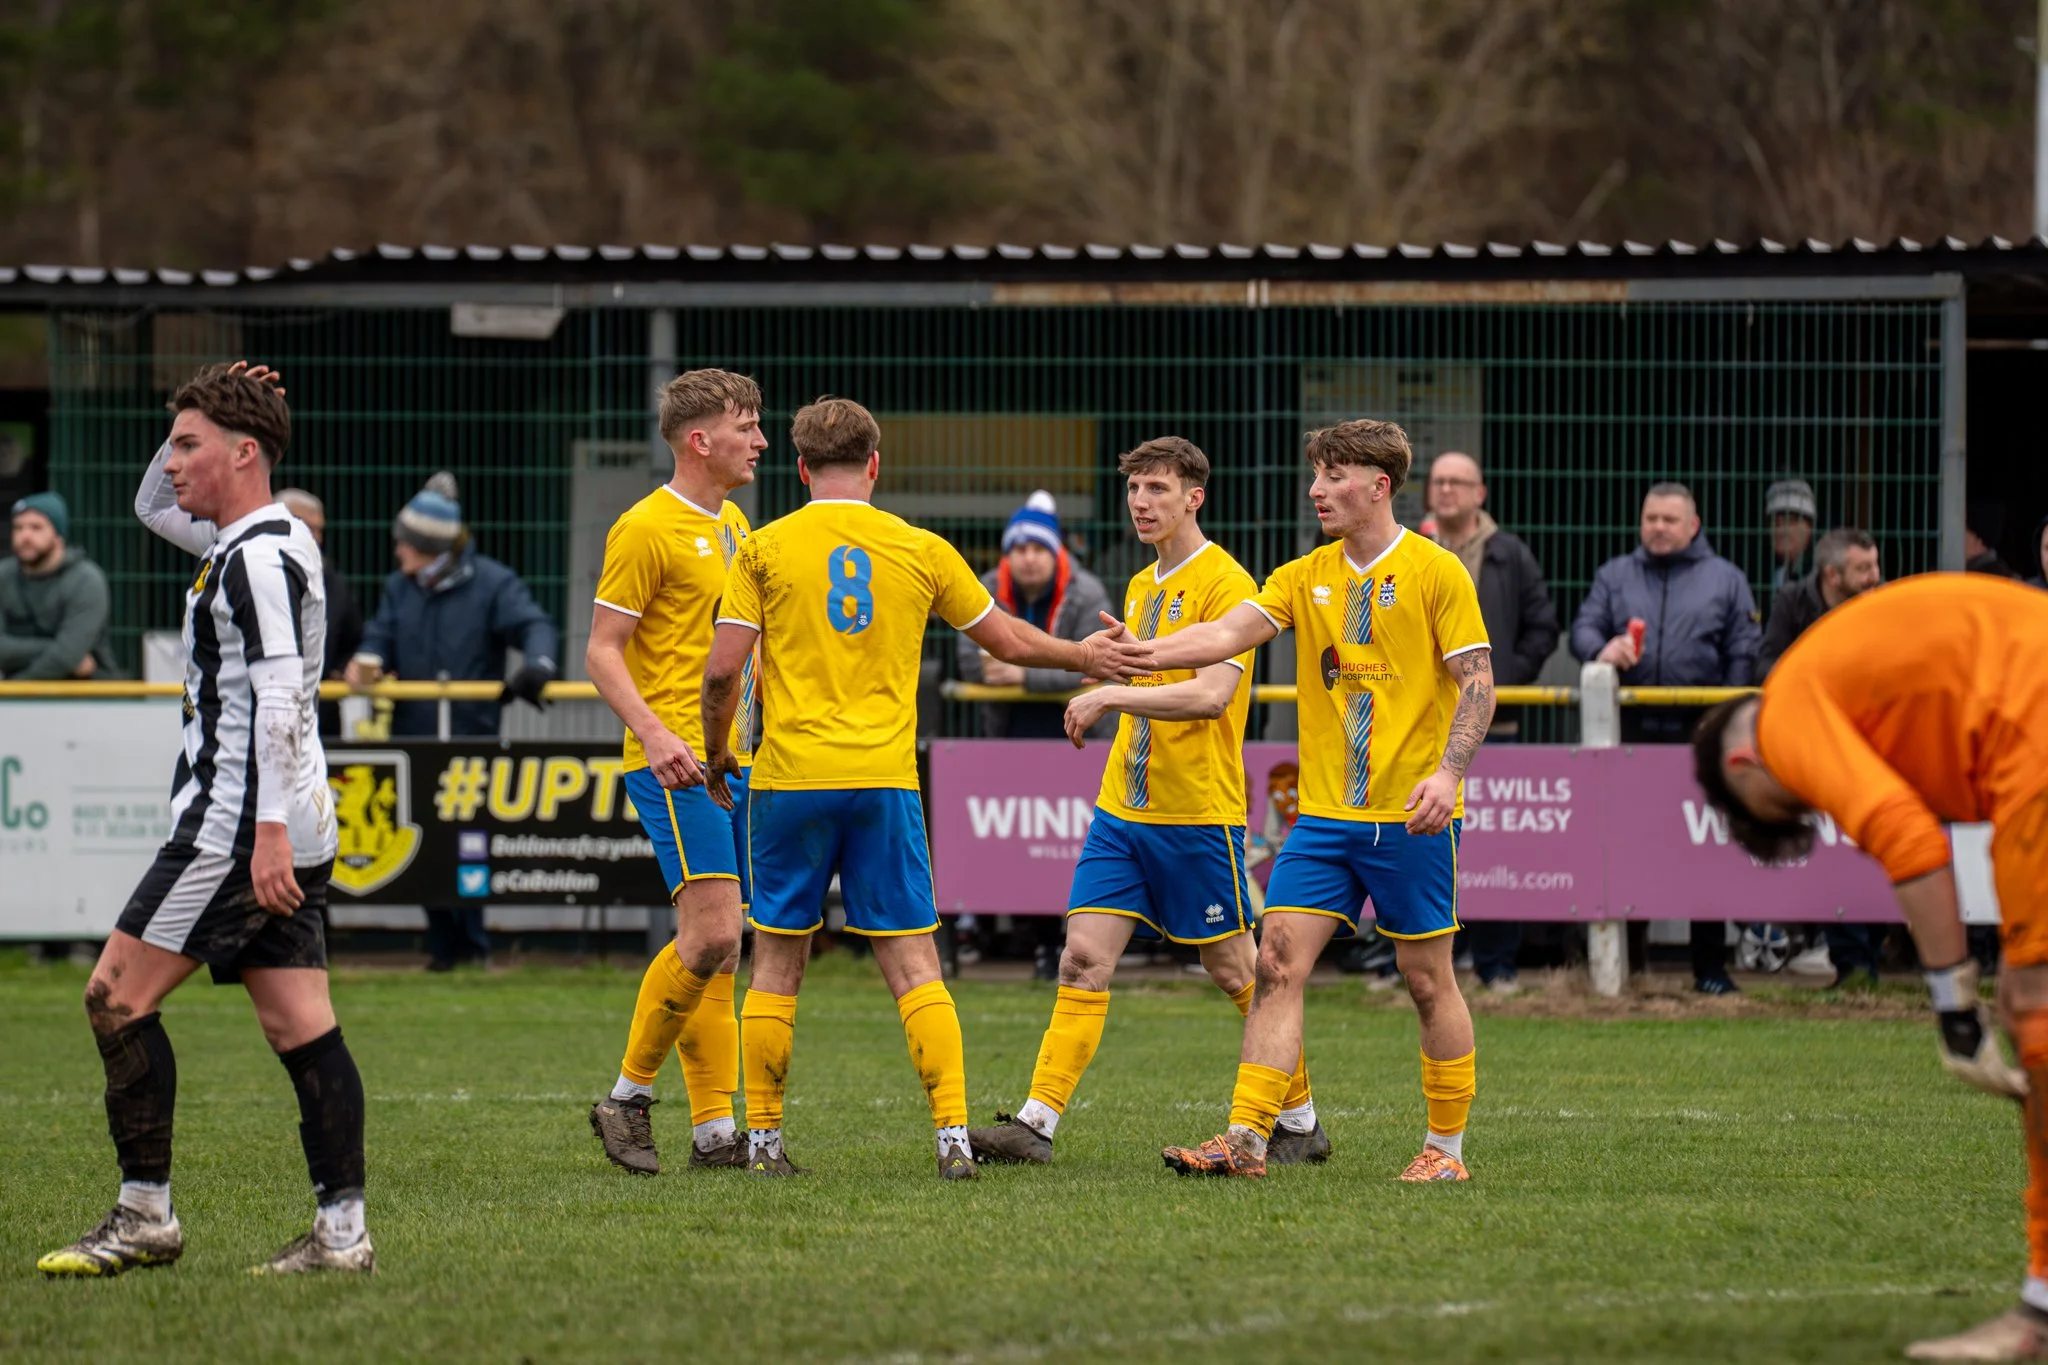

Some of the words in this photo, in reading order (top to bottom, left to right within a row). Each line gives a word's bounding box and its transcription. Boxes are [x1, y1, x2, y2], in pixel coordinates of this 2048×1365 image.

[827, 545, 873, 635] 8
[1341, 662, 1387, 673] HUGHES
[1342, 673, 1393, 681] HOSPITALITY
[434, 757, 639, 821] #UPT
[1487, 777, 1572, 802] WILLS
[1502, 807, 1572, 832] EASY
[1458, 865, 1573, 889] swills.com
